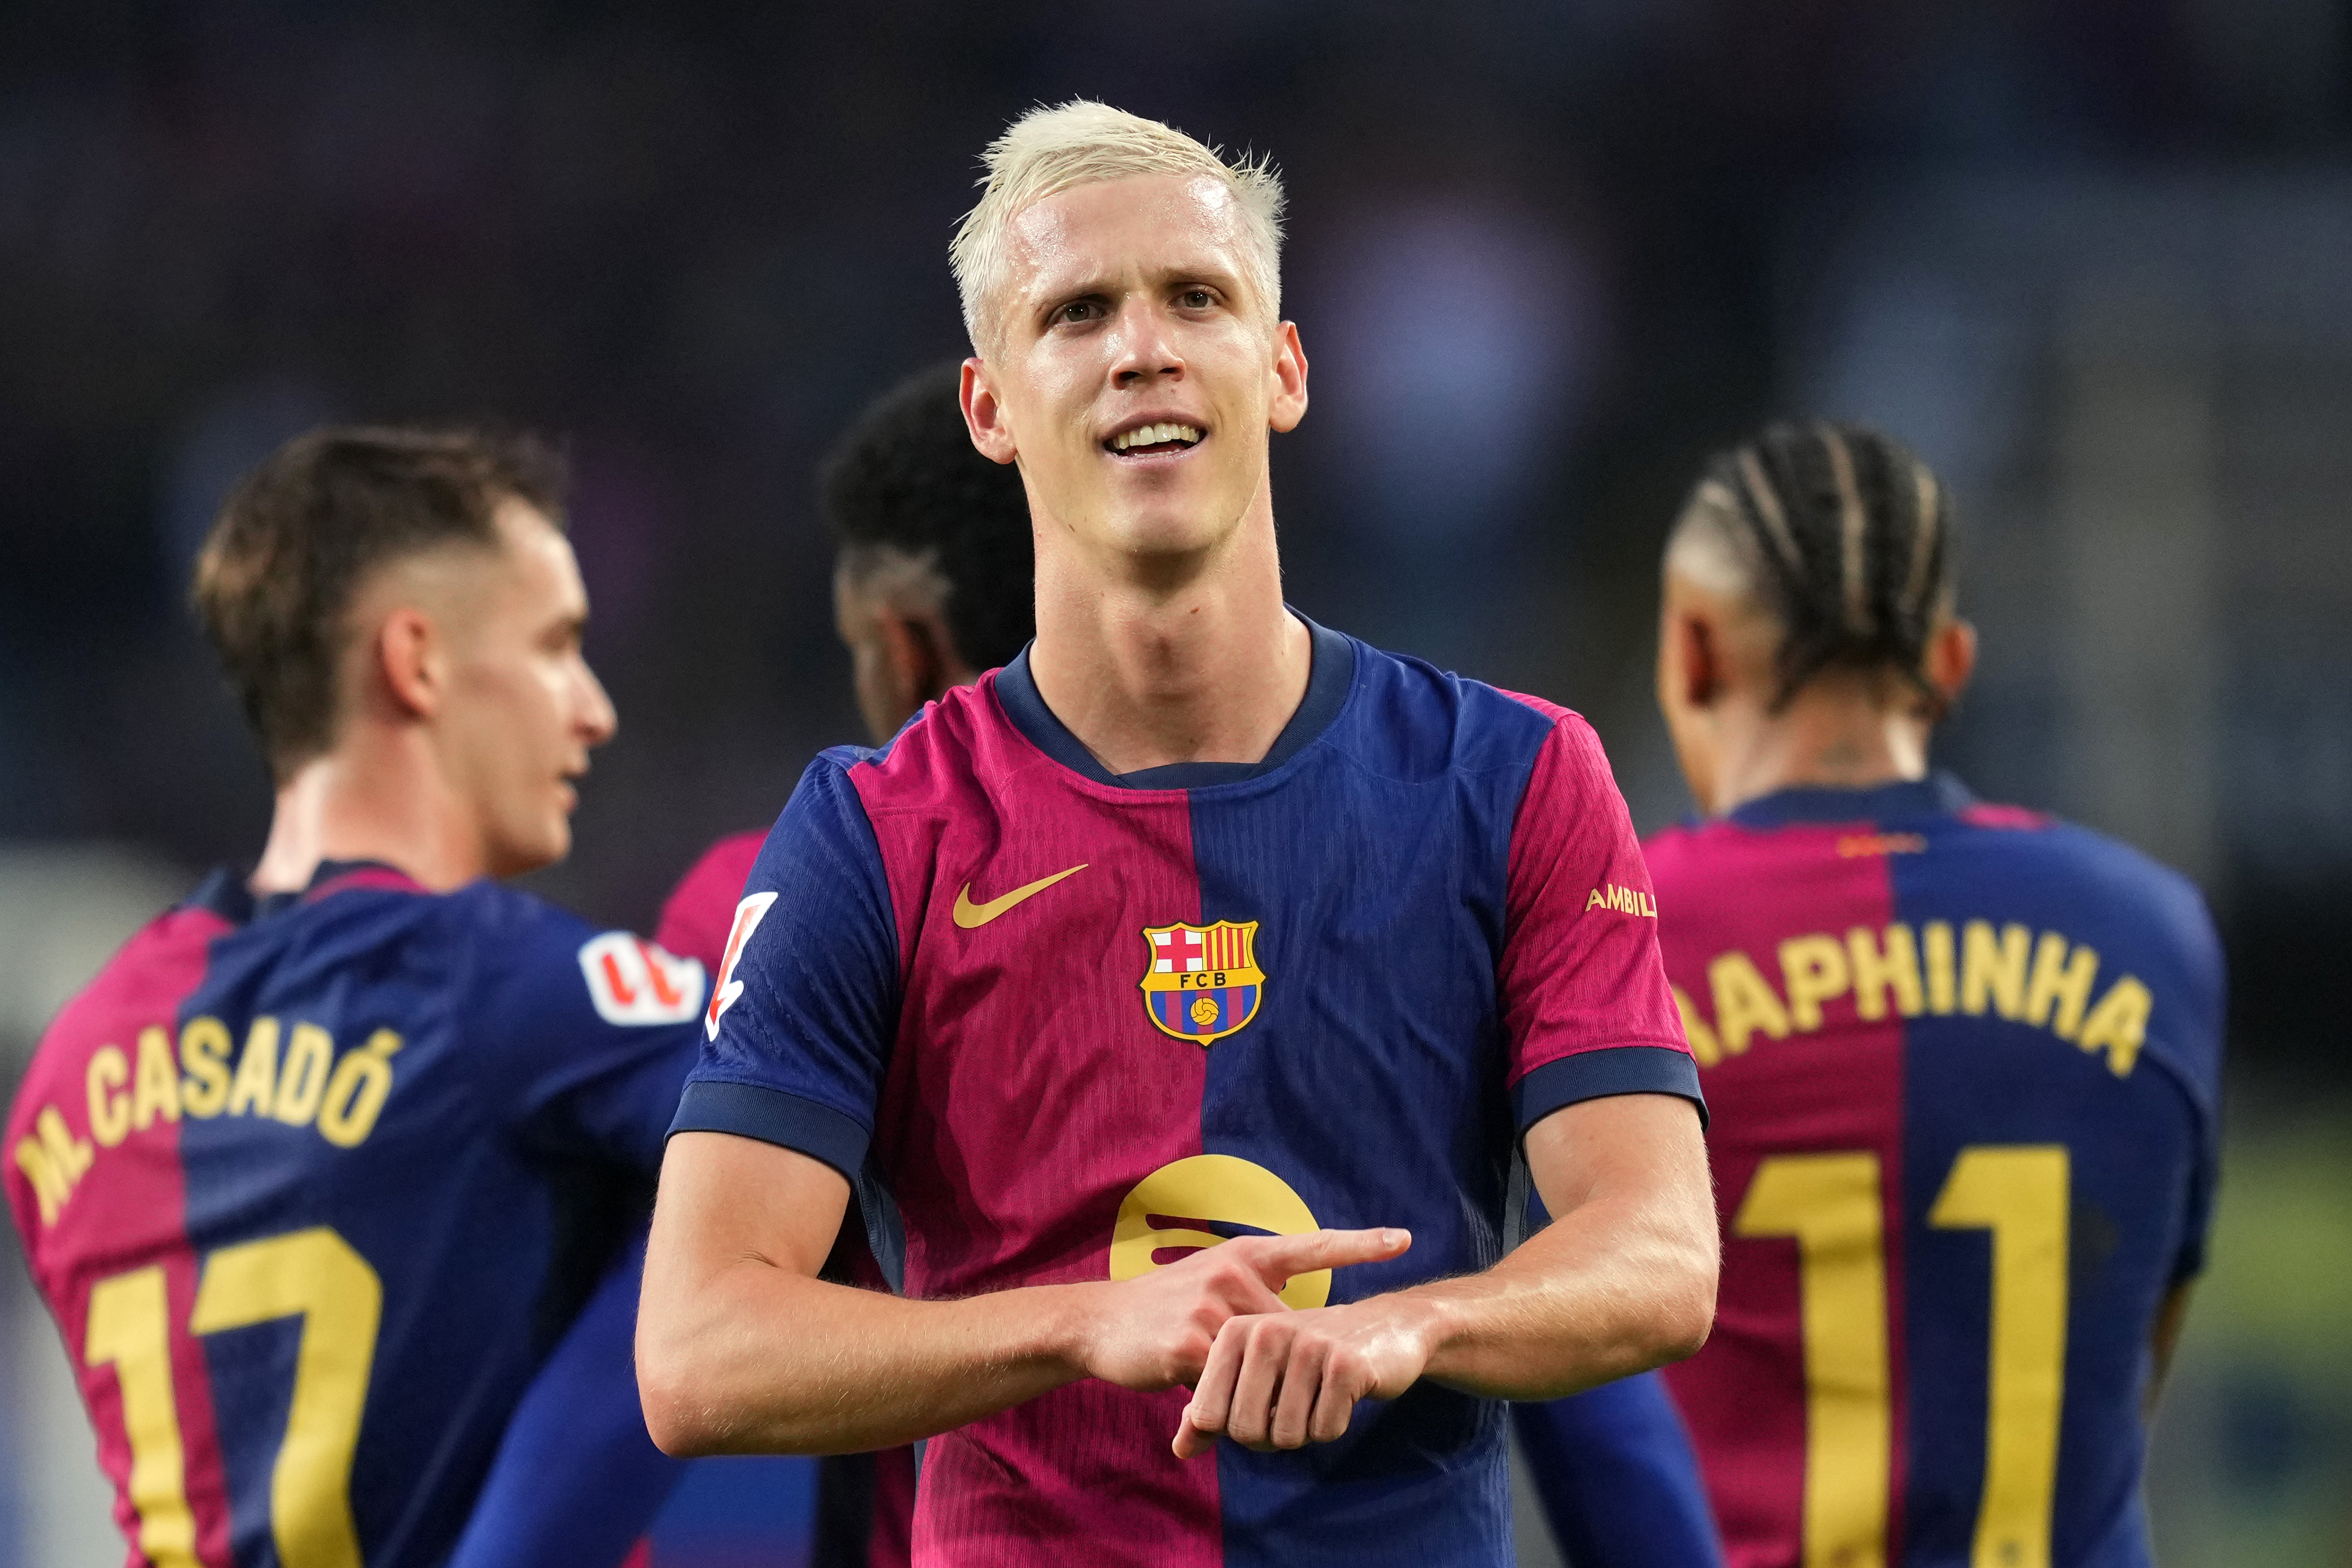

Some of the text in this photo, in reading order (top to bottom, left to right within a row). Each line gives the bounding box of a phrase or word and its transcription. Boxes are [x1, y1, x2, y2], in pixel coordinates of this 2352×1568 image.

[85, 1014, 405, 1150] CASADÓ
[84, 1225, 384, 1568] 17
[1733, 1142, 2070, 1568] 11
